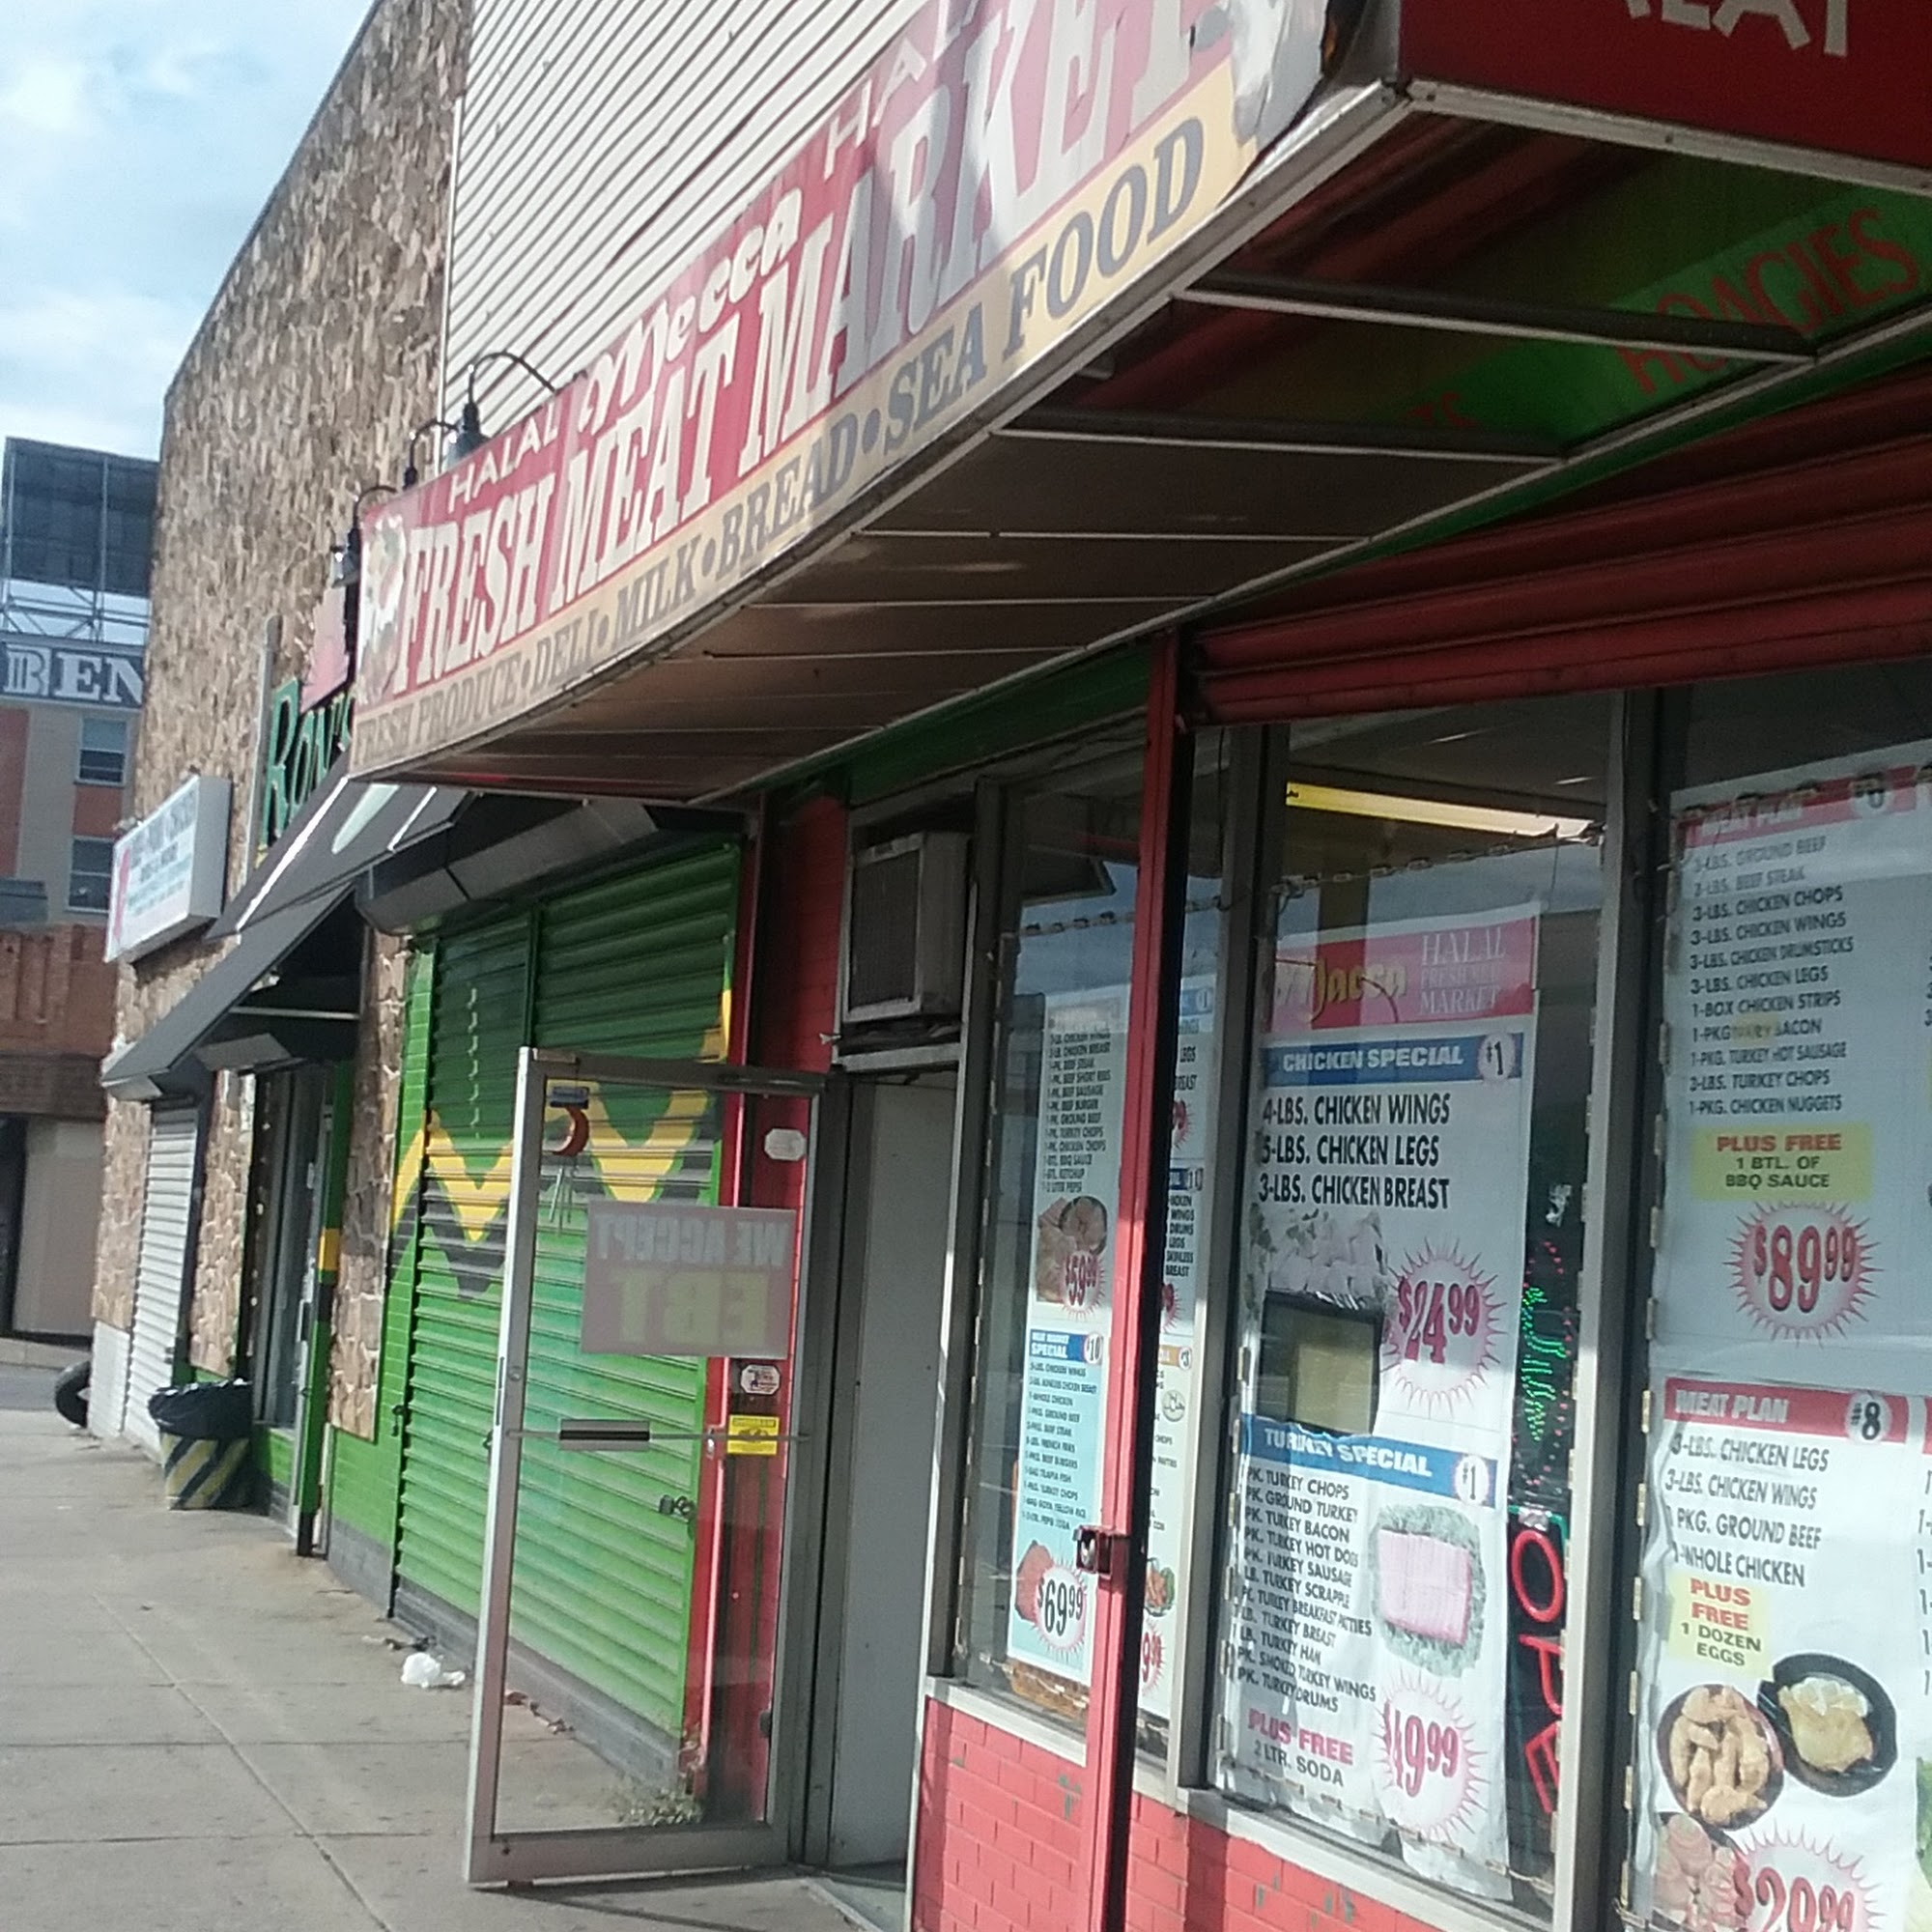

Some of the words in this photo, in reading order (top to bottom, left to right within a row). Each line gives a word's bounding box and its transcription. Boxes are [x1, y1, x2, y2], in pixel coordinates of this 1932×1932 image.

[415, 651, 523, 746] PRODUCE
[612, 533, 702, 649] MILK
[720, 412, 859, 578] BREAD
[883, 303, 987, 457] SEA
[1002, 117, 1205, 362] FOOD
[448, 401, 559, 512] HALAL
[393, 472, 558, 695] FRESH
[549, 311, 740, 613] MEAT
[1736, 894, 1791, 916] CHICKEN
[1794, 885, 1843, 907] CHOPS
[1736, 919, 1790, 941] CHICKEN
[1794, 911, 1847, 932] WINGS
[1421, 925, 1507, 966] HALAL
[1730, 946, 1778, 966] CHICKEN
[1736, 969, 1790, 990] CHICKEN
[1795, 965, 1830, 984] LEGS
[1421, 985, 1501, 1015] MARKET
[1691, 1001, 1734, 1018] 1-BOX
[1738, 995, 1794, 1013] CHICKEN
[1797, 989, 1841, 1009] STRIPS
[1283, 1049, 1363, 1072] CHICKEN
[1367, 1045, 1464, 1068] SPECIAL
[1796, 1041, 1847, 1062] SAUSAGE
[1732, 1071, 1784, 1090] TURKEY
[1785, 1068, 1831, 1088] CHOPS
[1263, 1094, 1308, 1125] 4-LBS.
[1314, 1094, 1381, 1125] CHICKEN
[1388, 1093, 1451, 1125] WINGS
[1729, 1096, 1785, 1115] CHICKEN
[1787, 1094, 1842, 1112] NUGGETS
[1317, 1134, 1388, 1165] CHICKEN
[1395, 1134, 1439, 1167] LEGS
[1717, 1134, 1776, 1152] PLUS
[1784, 1133, 1842, 1152] FREE
[1735, 1157, 1743, 1170] 1
[1750, 1156, 1791, 1170] BTL.
[1797, 1155, 1821, 1169] OF
[1259, 1173, 1306, 1204] 3-LBS.
[1312, 1175, 1380, 1206] CHICKEN
[1384, 1177, 1450, 1209] BREAST
[1725, 1174, 1763, 1190] BBQ
[1767, 1173, 1831, 1188] SAUCE
[1674, 1389, 1729, 1418] MEAT
[1730, 1394, 1789, 1425] PLAN
[1264, 1428, 1333, 1458] TURKEY
[1337, 1443, 1433, 1478] SPECIAL
[1719, 1436, 1789, 1468] CHICKEN
[1791, 1446, 1831, 1472] LEGS
[1266, 1468, 1304, 1492] TURKEY
[1307, 1479, 1350, 1501] CHOPS
[1664, 1467, 1704, 1494] 3-LBS.
[1708, 1473, 1769, 1503] CHICKEN
[1771, 1481, 1818, 1511] WINGS
[1265, 1490, 1313, 1515] GROUND
[1265, 1510, 1301, 1533] TURKEY
[1304, 1520, 1350, 1544] BACON
[1677, 1507, 1712, 1534] PKG.
[1716, 1513, 1786, 1545] GROUND
[1788, 1522, 1823, 1550] BEEF
[1267, 1550, 1304, 1575] TURKEY
[1305, 1540, 1331, 1561] HOT
[1263, 1569, 1302, 1595] TURKEY
[1735, 1552, 1805, 1589] CHICKEN
[1690, 1577, 1751, 1607] PLUS
[1262, 1609, 1301, 1635] TURKEY
[1302, 1623, 1336, 1648] BREAST
[1691, 1601, 1749, 1632] FREE
[1261, 1630, 1297, 1656] TURKEY
[1300, 1643, 1322, 1666] HAM
[1681, 1621, 1690, 1635] 1
[1697, 1624, 1762, 1653] DOZEN
[1696, 1641, 1746, 1667] EGGS
[1295, 1687, 1339, 1713] DRUMS
[1333, 1676, 1377, 1702] WINGS
[1247, 1707, 1292, 1746] PLUS
[1298, 1728, 1353, 1767] FREE
[1295, 1755, 1344, 1788] SODA
